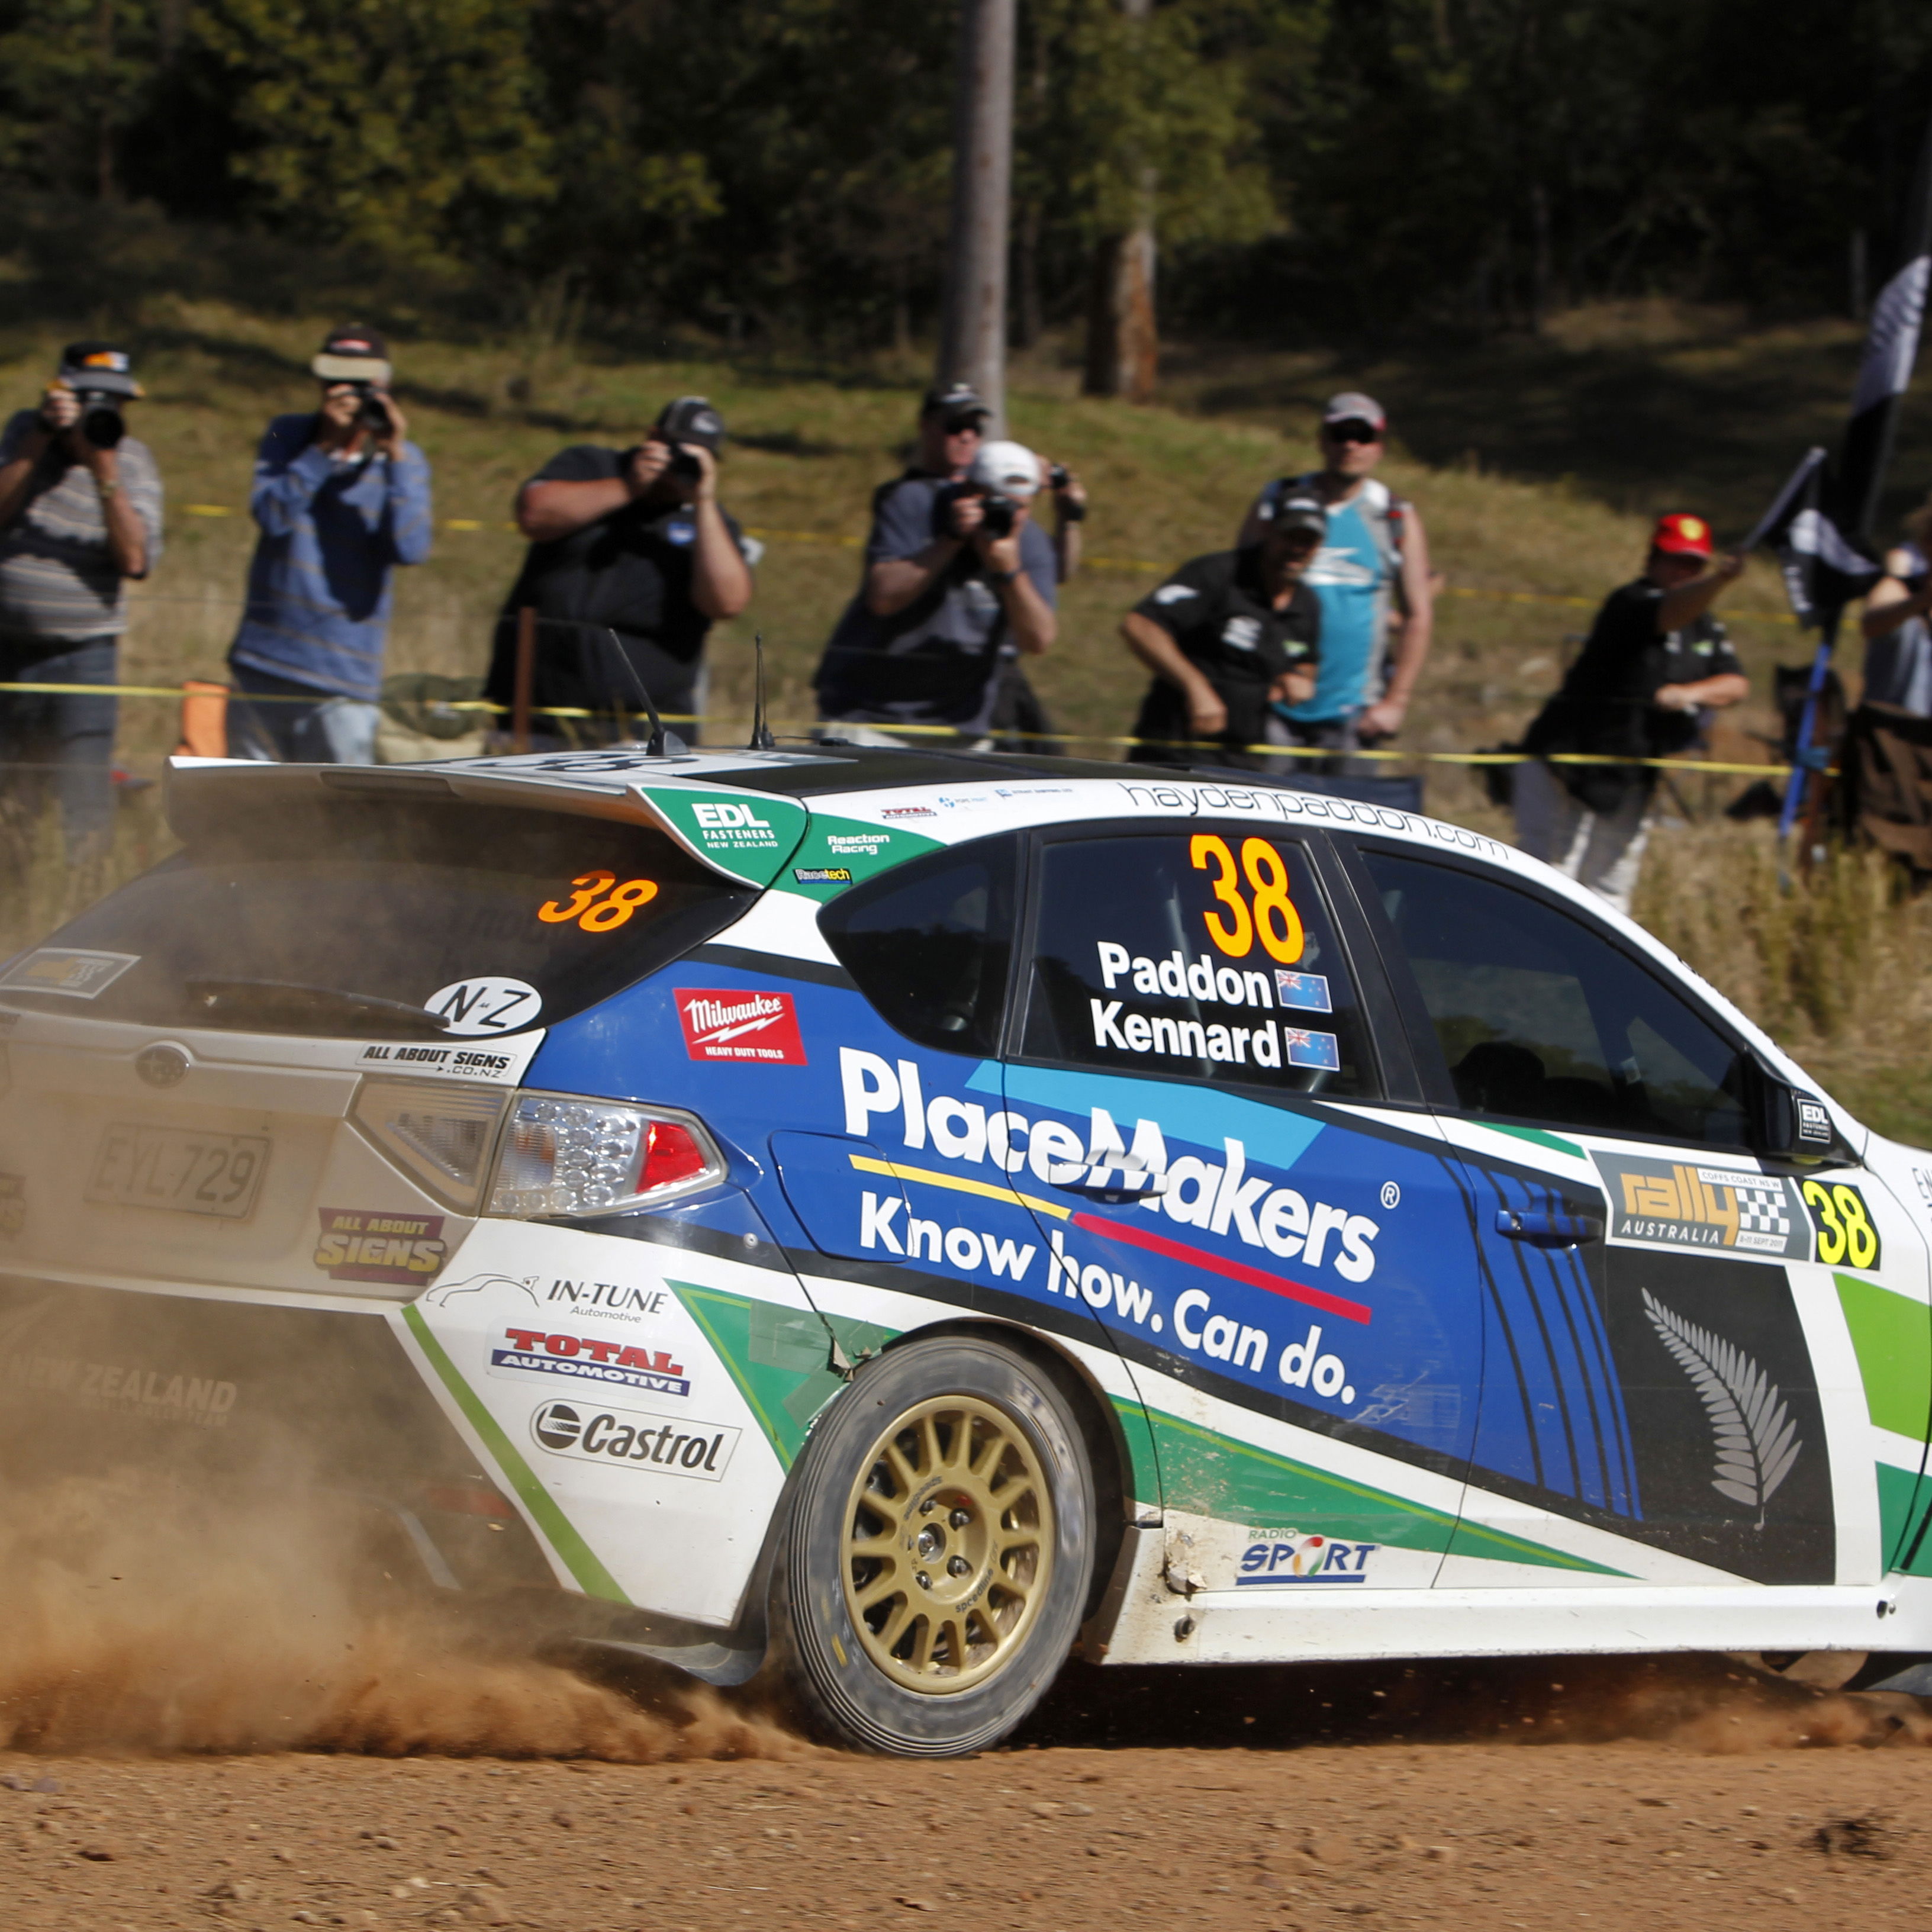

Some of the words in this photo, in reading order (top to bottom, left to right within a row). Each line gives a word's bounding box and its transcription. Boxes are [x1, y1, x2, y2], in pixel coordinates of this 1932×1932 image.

[691, 804, 770, 827] EDL
[703, 830, 775, 839] FASTENERS
[1117, 783, 1508, 860] haydenpaddon.com
[827, 834, 890, 845] Reaction
[832, 845, 877, 855] Racing
[537, 870, 658, 932] 38
[1189, 834, 1305, 964] 38
[1097, 941, 1274, 1008] Paddon
[683, 994, 783, 1033] Milwaukee
[705, 1046, 733, 1056] HEAVY
[735, 1047, 755, 1057] DUTY
[757, 1048, 784, 1059] TOOLS
[1090, 999, 1281, 1068] Kennard
[363, 1046, 391, 1060] ALL
[394, 1048, 452, 1063] ABOUT
[453, 1052, 510, 1070] SIGNS
[1802, 1105, 1829, 1125] EDL
[839, 1046, 1380, 1283] PlaceMakers
[1702, 1171, 1730, 1182] COFFS
[1731, 1175, 1757, 1184] COAST
[1620, 1165, 1741, 1245] rally
[1802, 1180, 1877, 1268] 38
[331, 1216, 362, 1231] ALL
[366, 1218, 430, 1235] ABOUT
[1621, 1219, 1719, 1244] AUSTRALIA
[315, 1233, 445, 1272] SIGNS
[546, 1279, 668, 1315] IN-TUNE
[569, 1305, 641, 1324] Automotive
[860, 1191, 1036, 1282] Know
[1046, 1228, 1163, 1333] how.
[1173, 1287, 1269, 1373] Can
[1279, 1325, 1356, 1406] do.
[505, 1327, 683, 1376] TOTAL
[80, 1363, 237, 1413] ZEALAND
[500, 1354, 683, 1393] AUTOMOTIVE
[581, 1413, 724, 1472] Castrol
[1248, 1528, 1297, 1540] RADIO
[1241, 1537, 1379, 1576] SPORT
